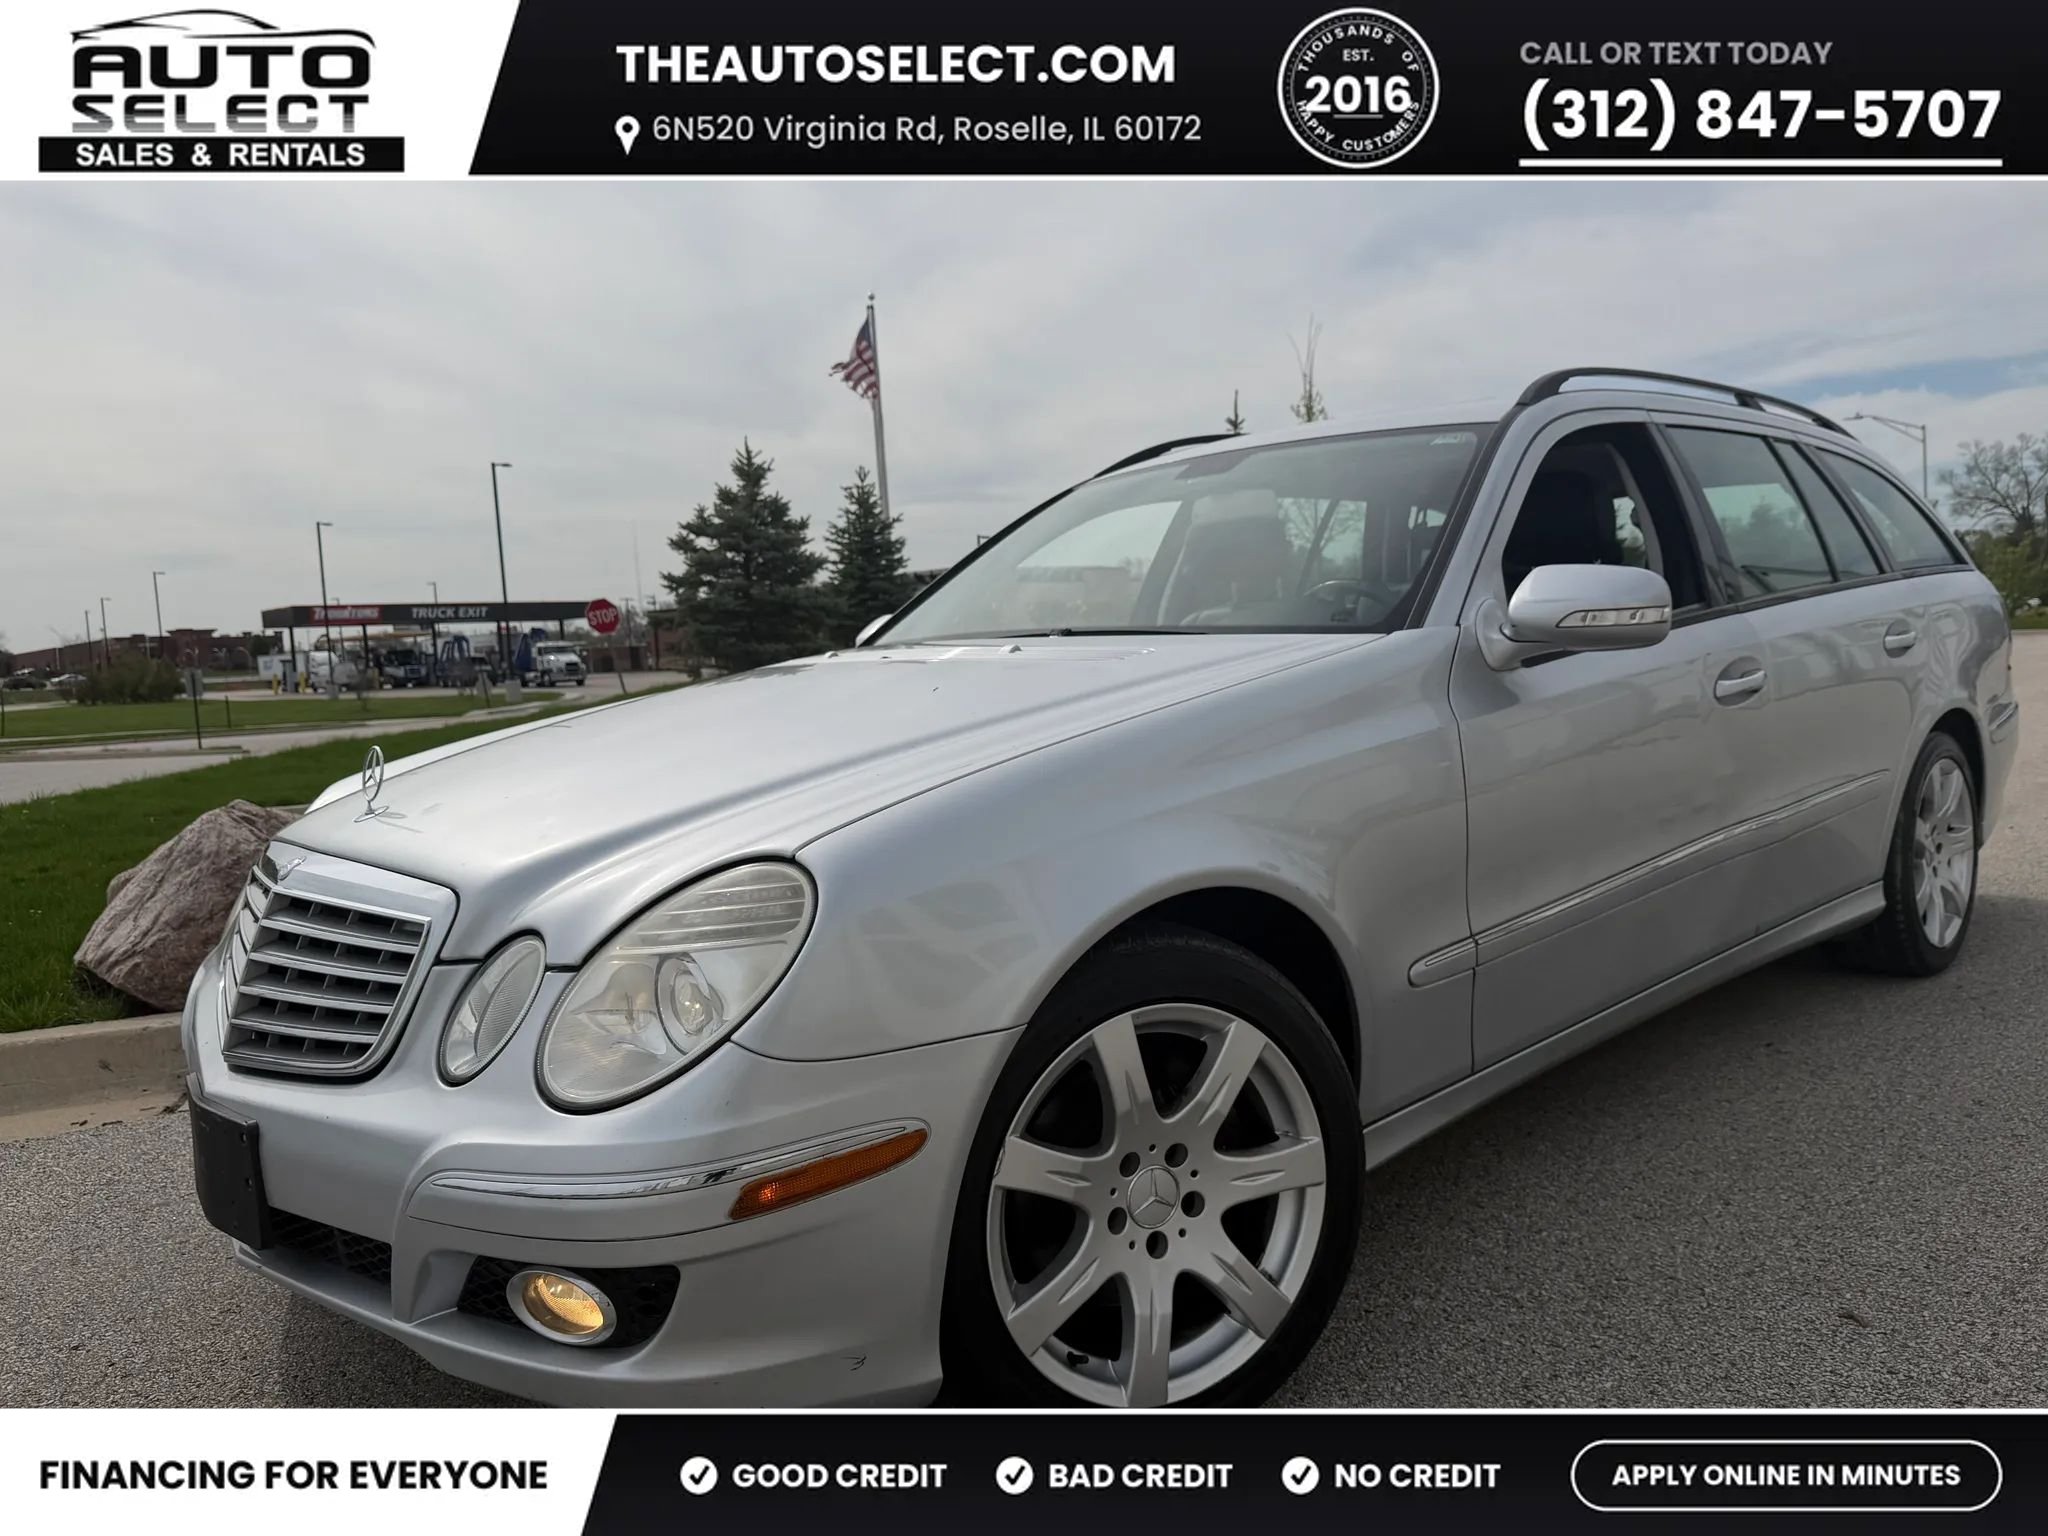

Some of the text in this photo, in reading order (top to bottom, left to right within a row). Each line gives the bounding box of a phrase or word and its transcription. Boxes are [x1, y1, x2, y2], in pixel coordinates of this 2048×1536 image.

[412, 605, 488, 619] TRUCK EXIT
[589, 607, 617, 626] STOP
